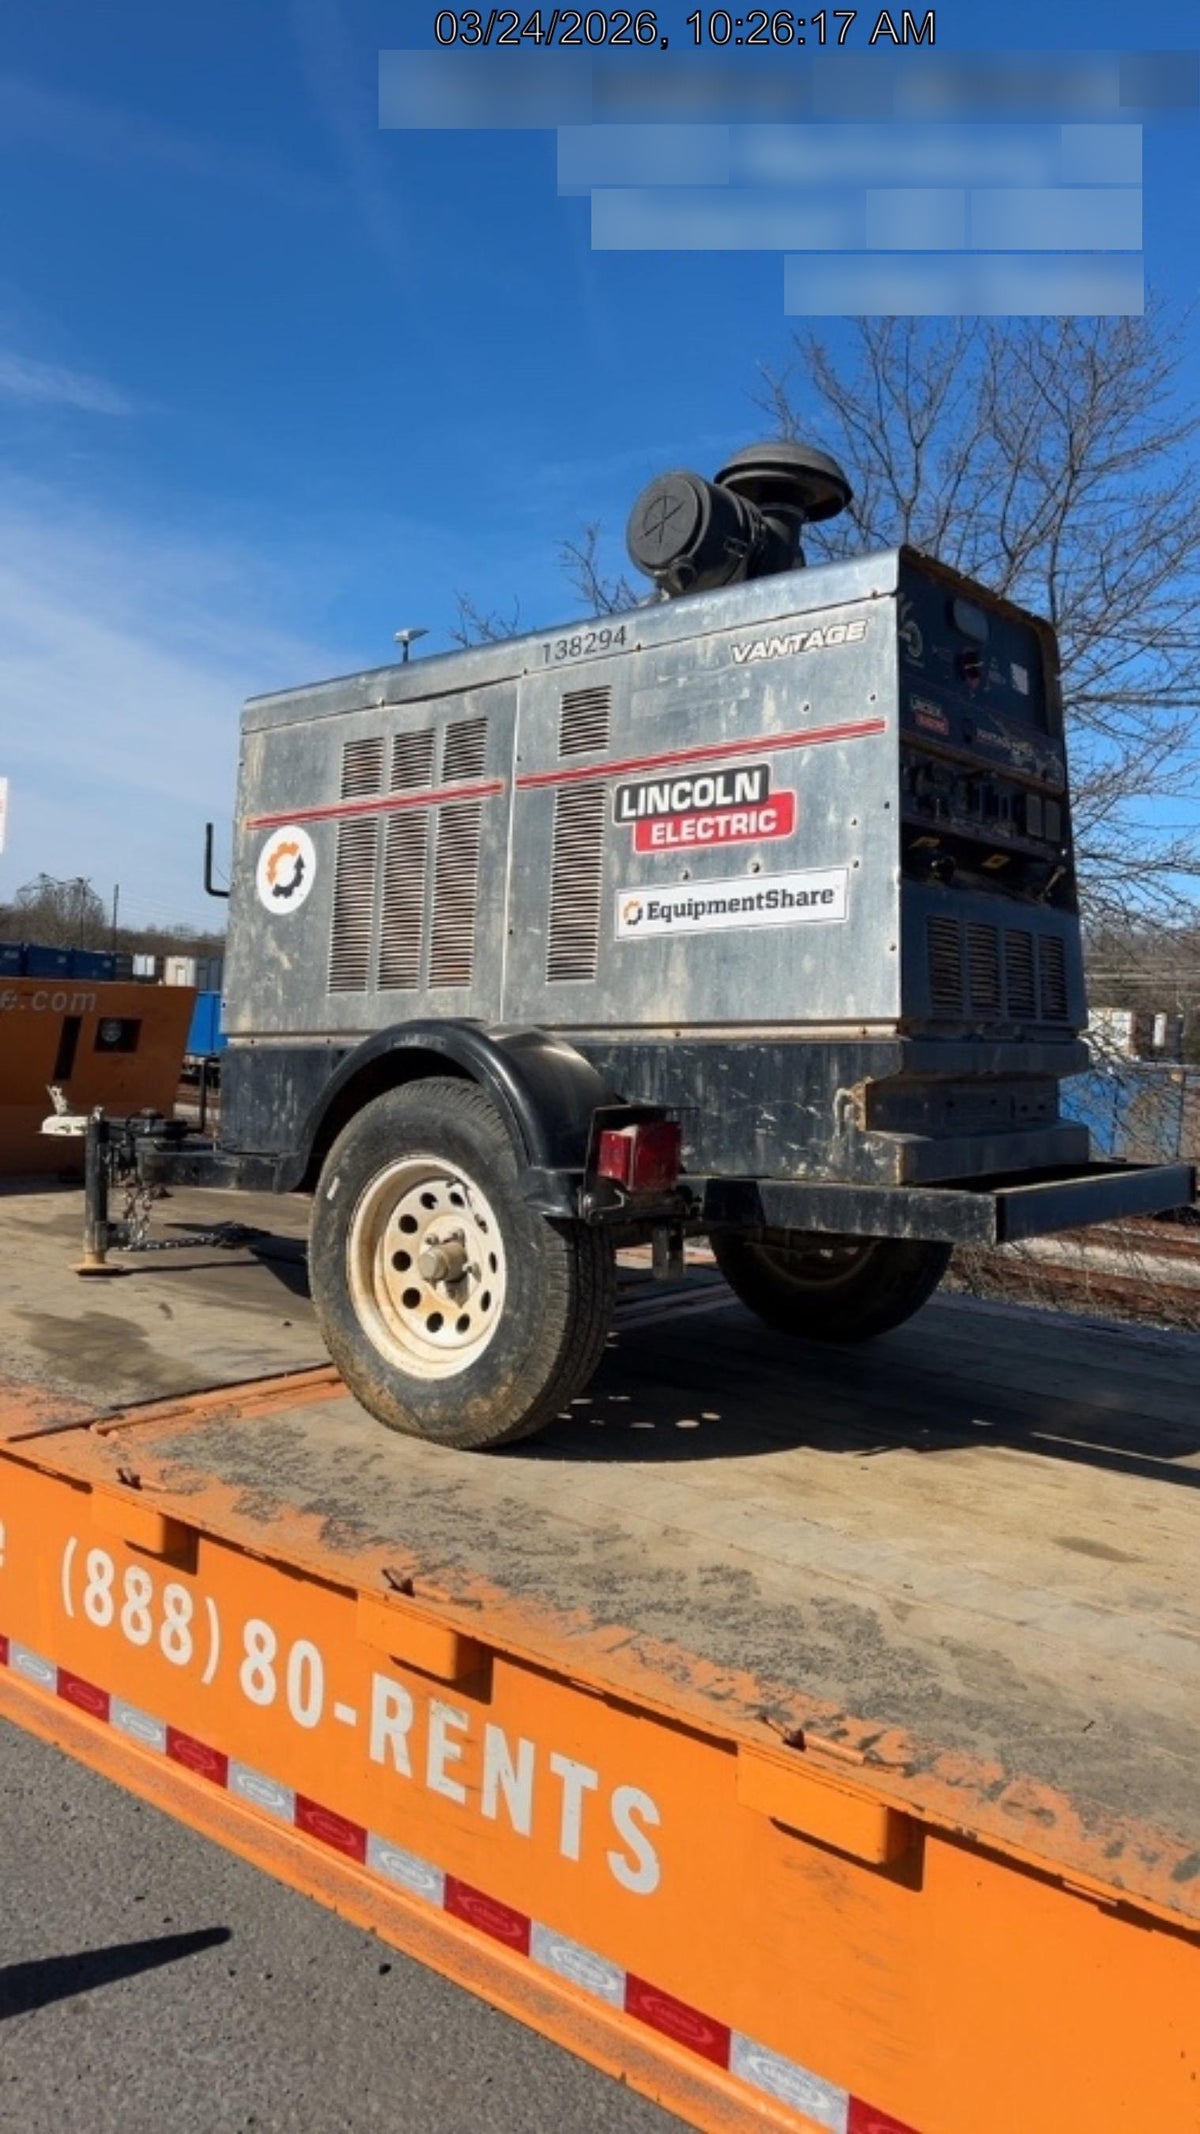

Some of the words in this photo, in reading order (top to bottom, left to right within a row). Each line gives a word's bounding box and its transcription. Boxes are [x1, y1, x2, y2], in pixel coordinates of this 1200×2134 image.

[542, 625, 627, 663] 138294
[731, 620, 868, 664] VANTAGE
[620, 771, 761, 818] LINCOLN
[650, 809, 778, 844] ELECTRIC
[646, 888, 835, 924] EquipmentShare
